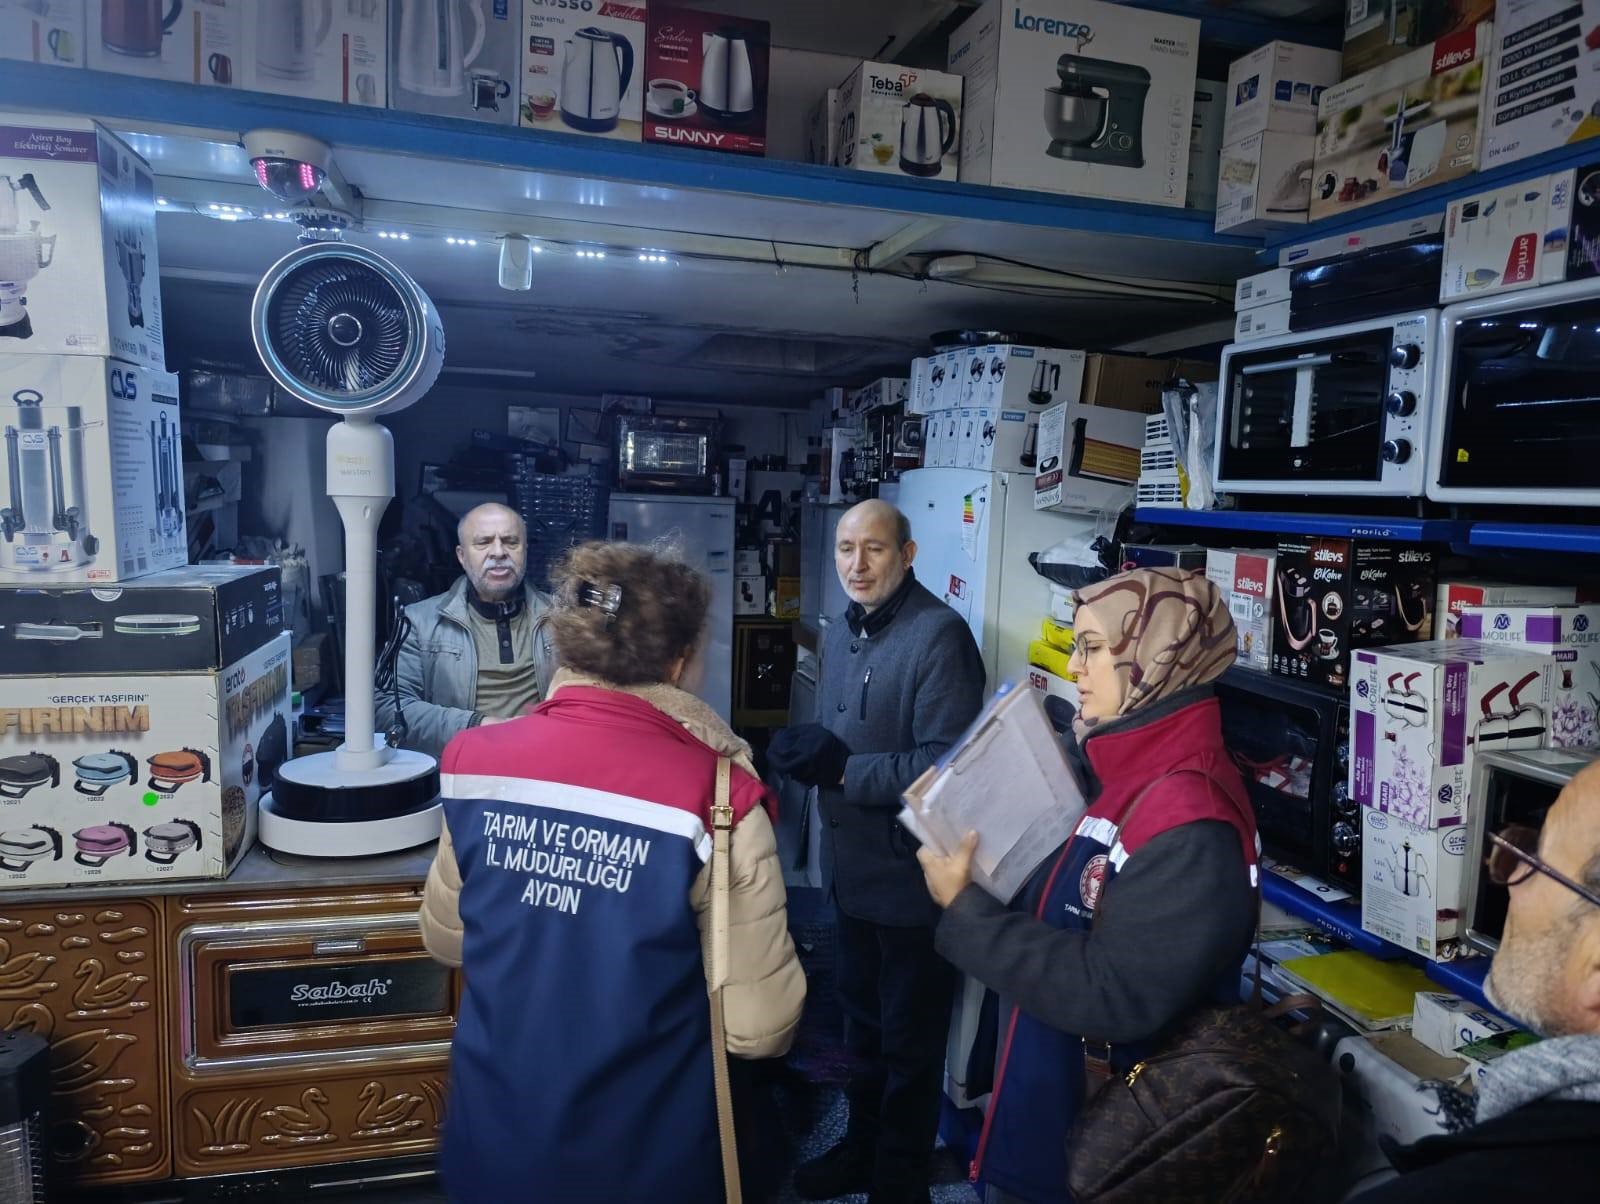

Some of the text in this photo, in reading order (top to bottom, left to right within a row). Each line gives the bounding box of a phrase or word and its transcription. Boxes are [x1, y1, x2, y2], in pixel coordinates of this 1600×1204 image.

[1015, 8, 1091, 39] Lorenzo
[1435, 48, 1471, 70] stilevs
[870, 75, 903, 92] Teba
[654, 126, 725, 145] SUNNY
[1517, 236, 1530, 280] arnica
[1313, 548, 1344, 563] stilevs
[1398, 550, 1432, 563] stilevs
[1236, 577, 1264, 593] stilevs
[1483, 630, 1521, 642] MORLIFE
[1369, 668, 1378, 713] MORLIFE
[1454, 768, 1464, 816] MORLIFE
[483, 811, 651, 866] TARIM VE ORMAN
[486, 837, 633, 894] İL MÜDÜRLÜĞÜ
[521, 878, 581, 915] AYDIN
[291, 979, 388, 1001] Sabah
